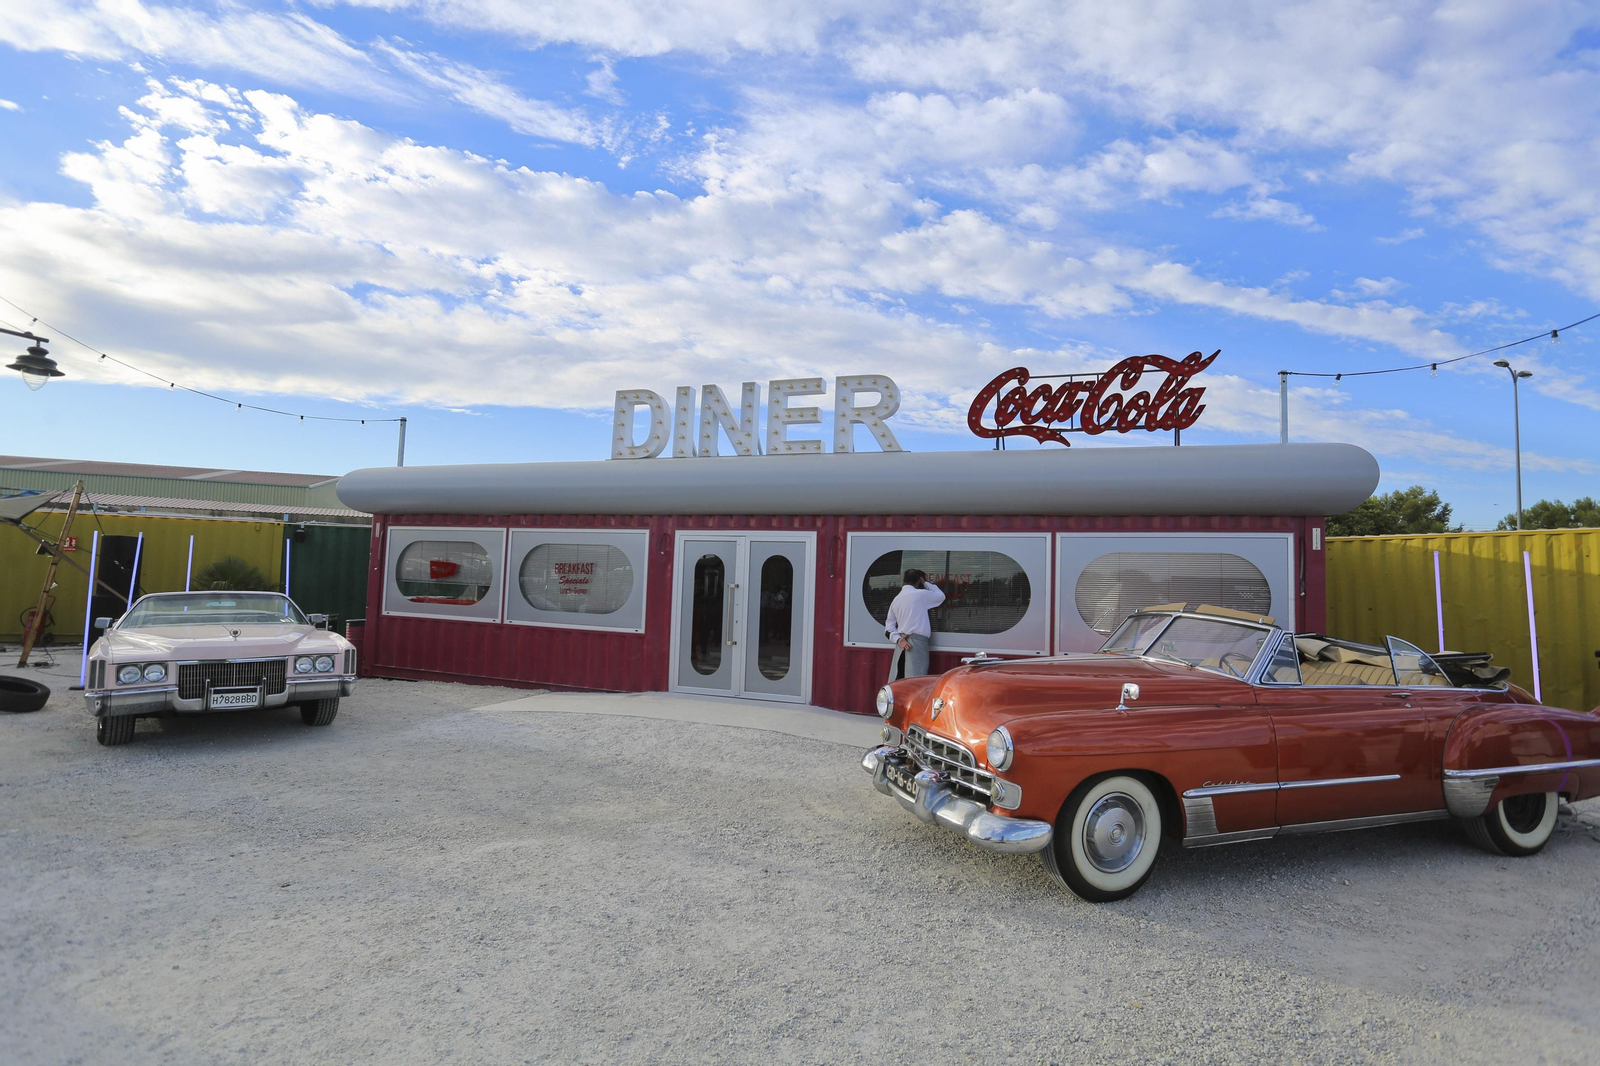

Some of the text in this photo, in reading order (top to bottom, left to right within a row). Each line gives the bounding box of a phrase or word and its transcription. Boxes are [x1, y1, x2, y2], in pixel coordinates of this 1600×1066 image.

[967, 349, 1221, 447] Coca-Cola
[611, 374, 902, 460] DINER
[555, 563, 594, 574] BREAKFAST
[558, 575, 589, 585] Specials
[1202, 780, 1255, 788] Cadillac
